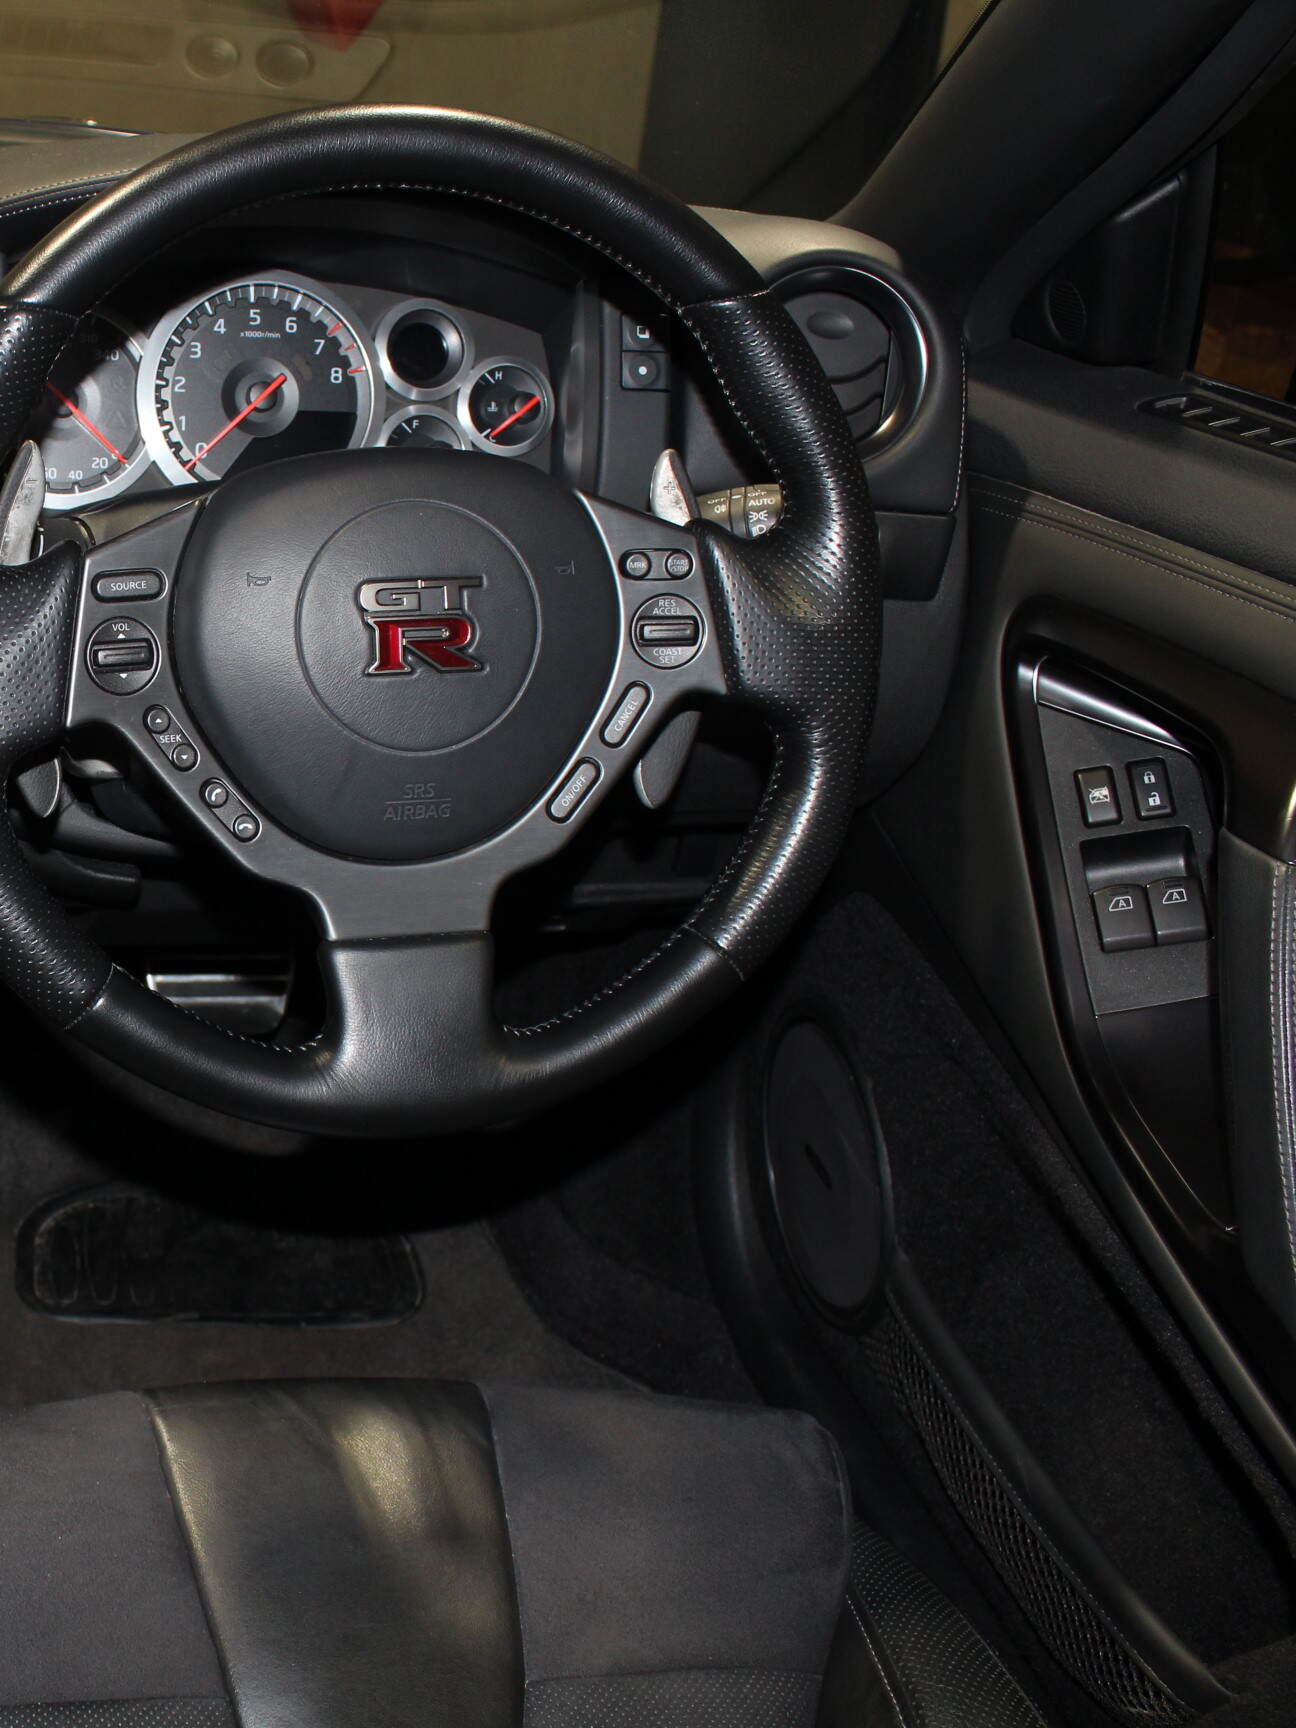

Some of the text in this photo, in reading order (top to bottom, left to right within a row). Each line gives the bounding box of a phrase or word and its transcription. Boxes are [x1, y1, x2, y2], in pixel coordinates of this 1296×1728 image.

[249, 309, 260, 325] 5
[285, 317, 298, 333] 6
[213, 318, 226, 334] 4
[190, 341, 202, 359] 3
[314, 339, 325, 355] 7
[330, 368, 343, 384] 8
[495, 371, 503, 380] H
[174, 376, 186, 393] 2
[178, 415, 186, 431] 1
[412, 420, 420, 429] F
[91, 457, 109, 469] 20
[68, 470, 83, 480] 40
[748, 497, 775, 507] AUTO
[629, 561, 647, 569] MRK
[110, 580, 148, 591] SOURCE
[359, 575, 484, 613] GT
[652, 607, 682, 615] ACCEL
[658, 599, 676, 607] RES
[112, 623, 130, 632] VOL
[364, 614, 483, 676] R
[653, 648, 682, 656] COAST
[659, 656, 674, 664] SET
[614, 699, 640, 733] CANCEL
[159, 734, 182, 744] SEEK
[403, 782, 436, 799] SRS
[561, 775, 587, 807] ON/OFF
[384, 803, 452, 821] AIRBAG
